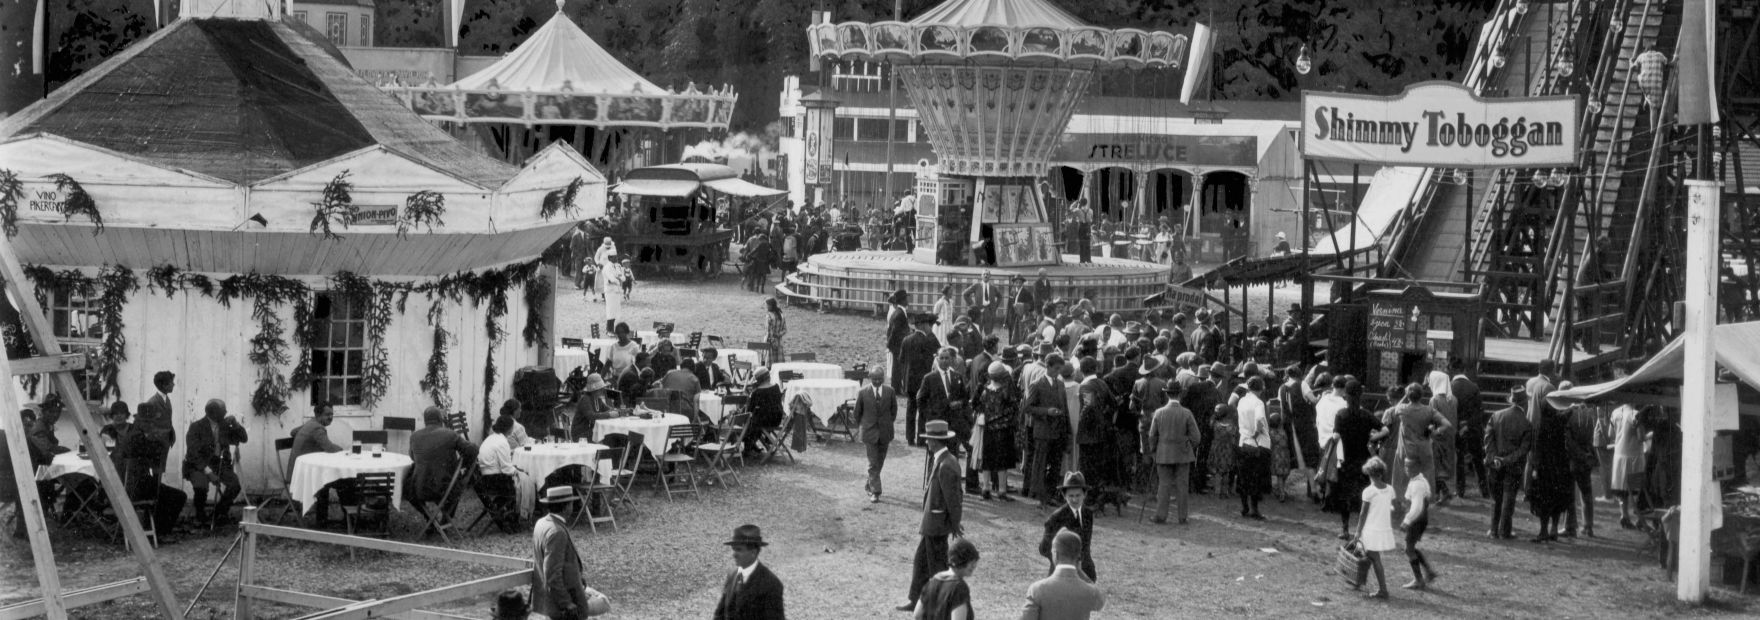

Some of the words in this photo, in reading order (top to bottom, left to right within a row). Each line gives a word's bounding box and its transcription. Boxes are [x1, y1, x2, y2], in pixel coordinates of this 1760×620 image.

[1314, 105, 1418, 153] Shimmy
[1422, 109, 1564, 157] Toboggan
[36, 191, 57, 201] VINO
